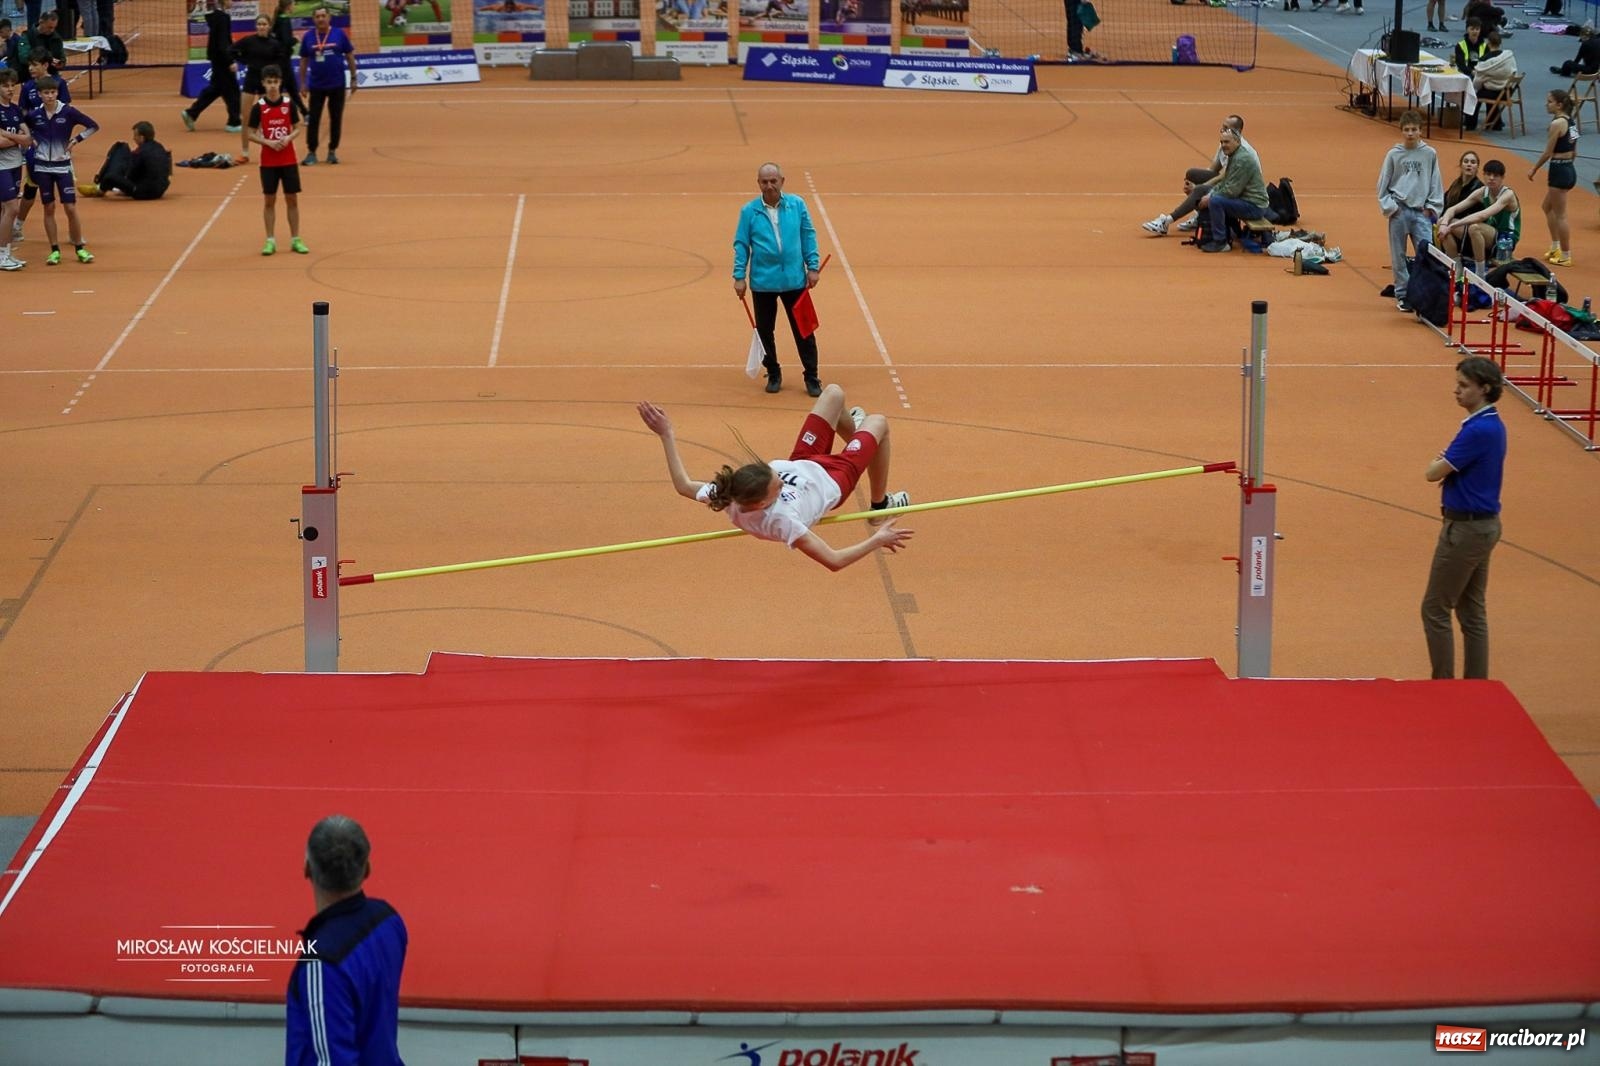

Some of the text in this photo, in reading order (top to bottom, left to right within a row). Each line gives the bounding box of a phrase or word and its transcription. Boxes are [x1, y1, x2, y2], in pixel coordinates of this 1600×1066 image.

[359, 56, 401, 65] MISTRZOSTWA
[402, 55, 441, 63] SPORTOWEGO
[890, 59, 912, 67] SZKOŁA
[913, 60, 955, 68] MISTRZOSTWA
[956, 61, 995, 70] SPORTOWEGO
[1254, 550, 1264, 581] polanik
[315, 570, 325, 597] polanik
[777, 1042, 920, 1066] polanik
